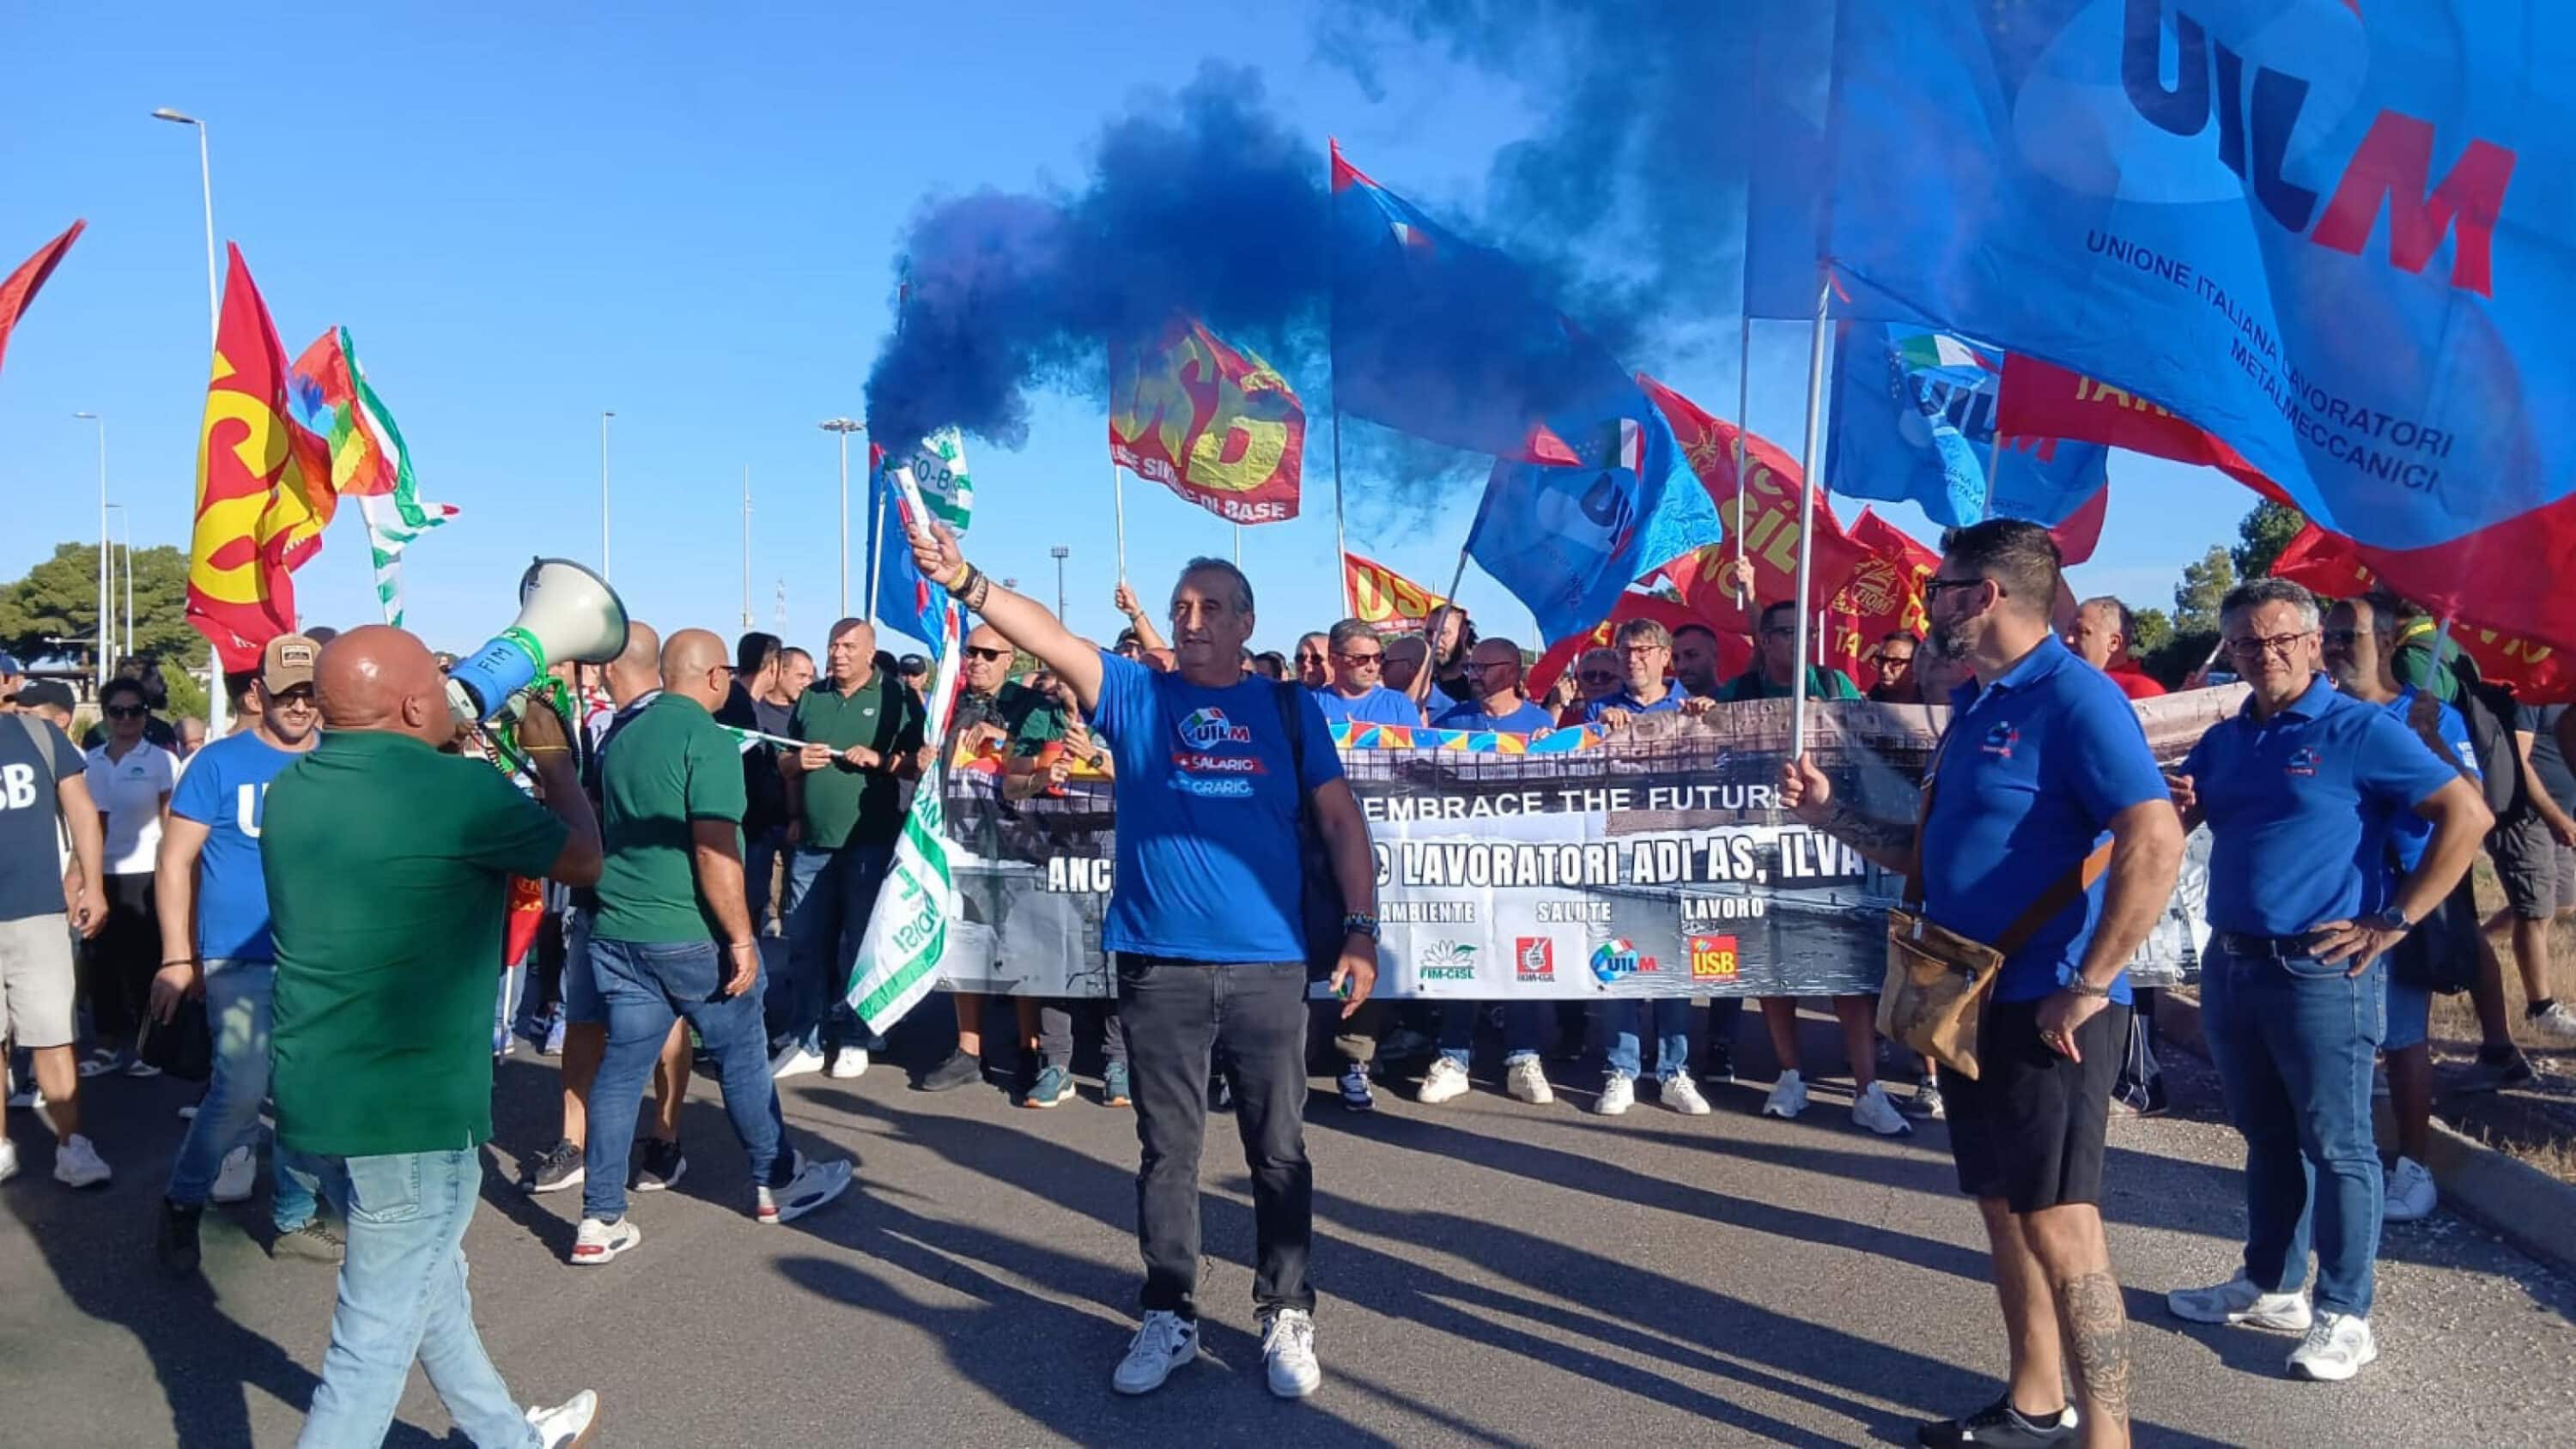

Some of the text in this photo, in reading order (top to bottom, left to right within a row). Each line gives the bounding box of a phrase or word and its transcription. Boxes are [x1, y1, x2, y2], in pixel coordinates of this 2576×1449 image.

[2121, 0, 2517, 299] UILM
[2087, 228, 2192, 289] UNIONE
[2196, 274, 2279, 361] ITALIANA
[2281, 359, 2455, 458] LAVORATORI
[2230, 336, 2439, 493] METALMECCANICI
[1224, 498, 1286, 518] BASE
[1357, 566, 1453, 622] US
[478, 646, 513, 675] FIM
[1196, 724, 1250, 743] UILM
[1192, 755, 1255, 771] SALARIO
[1362, 791, 1544, 822] EMBRACE
[1558, 788, 1631, 812] THE
[1401, 841, 1619, 888] LAVORATORI
[1632, 838, 1692, 886] ADI
[1707, 834, 1768, 885] AS,
[1780, 831, 1866, 878] ILVA
[1380, 898, 1765, 924] AMBIENTE SALUTE LAVORO
[1419, 966, 1475, 979] FIM-CISL
[1607, 956, 1658, 973] UILM
[1692, 952, 1735, 975] USB
